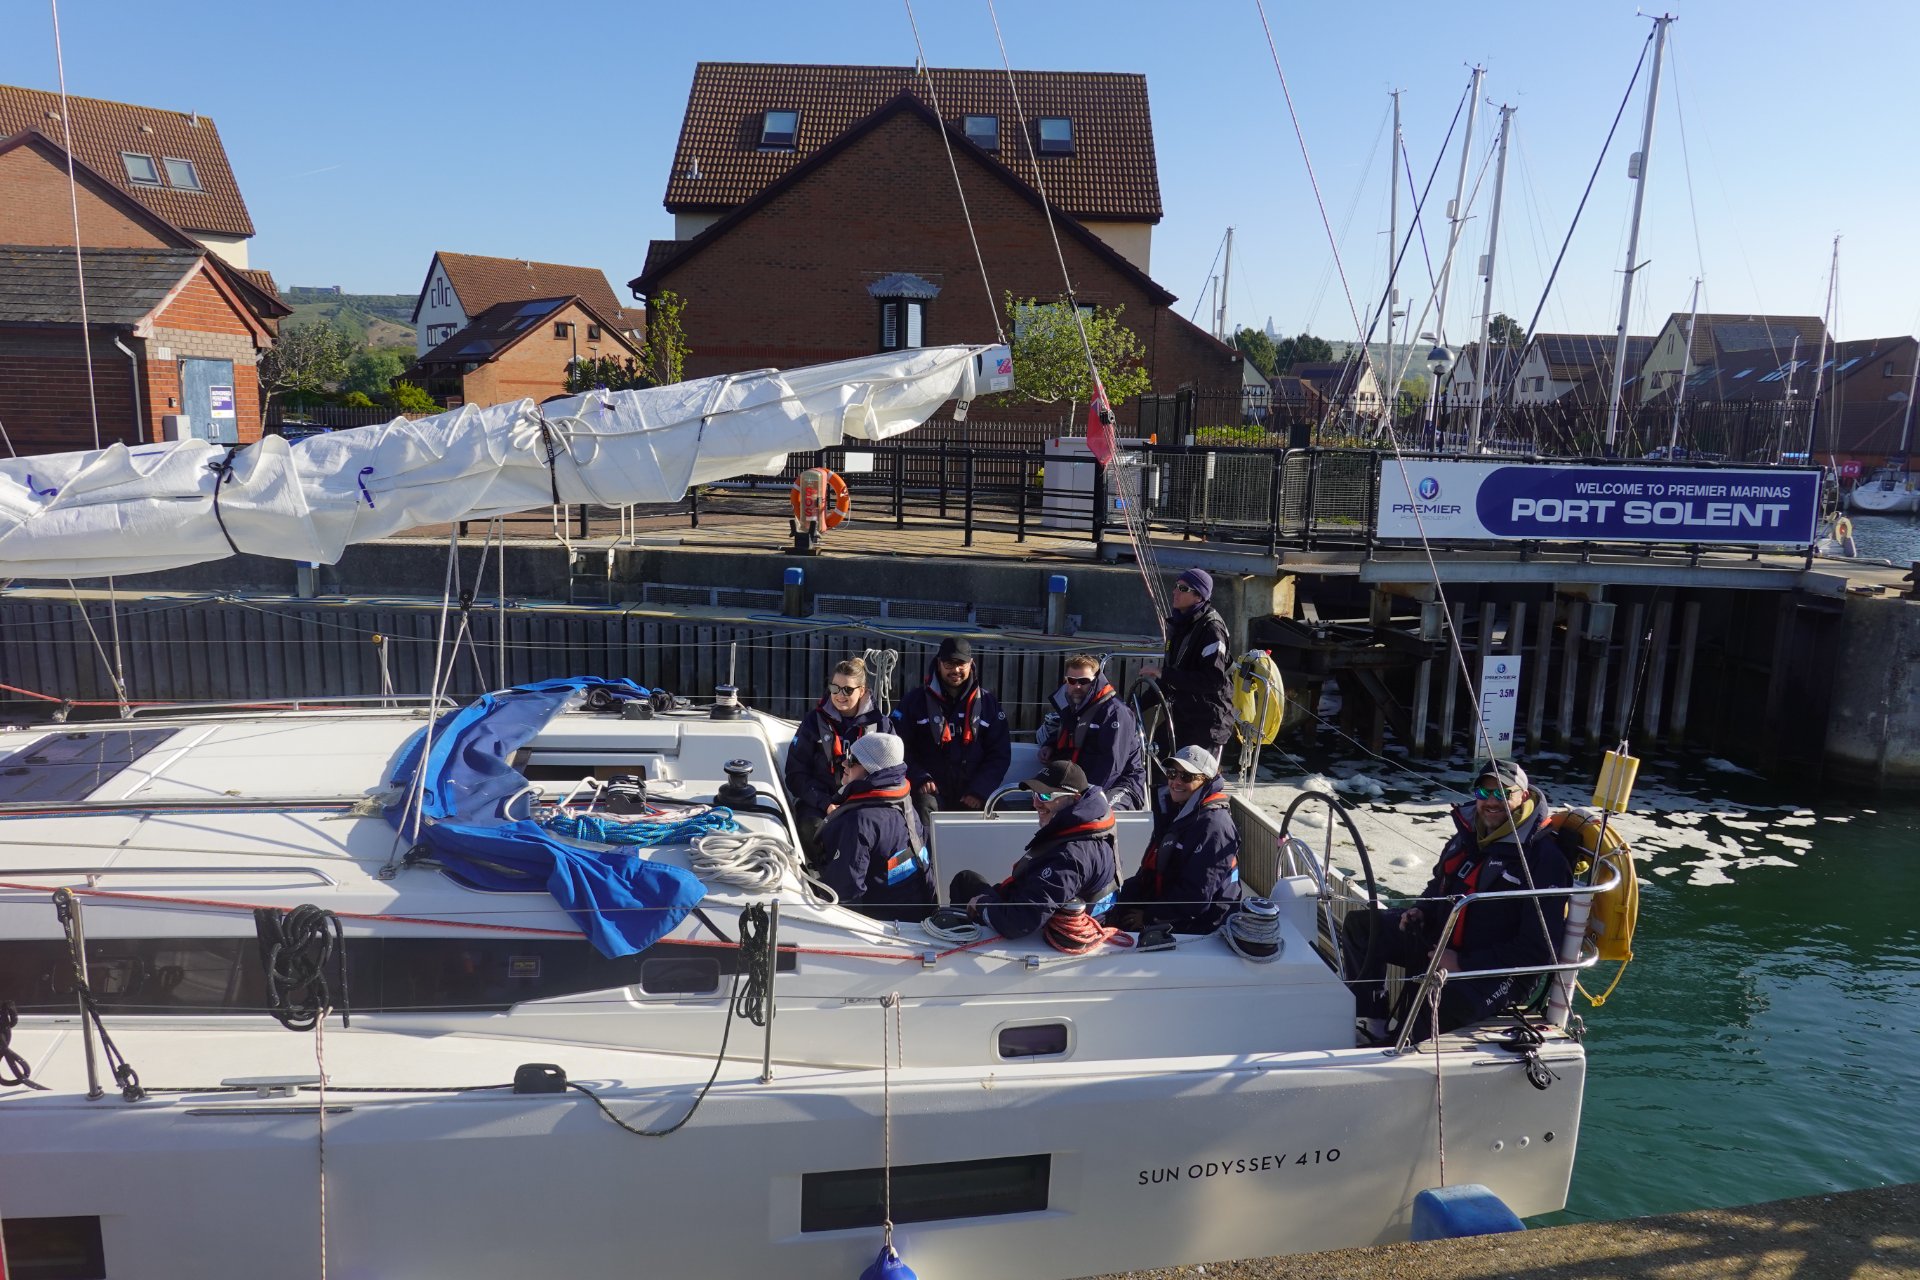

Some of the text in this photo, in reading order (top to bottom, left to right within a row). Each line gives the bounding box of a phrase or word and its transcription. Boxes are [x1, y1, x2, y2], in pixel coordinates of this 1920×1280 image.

[1576, 482, 1791, 498] WELCOME TO PREMIER MARINAS
[1392, 504, 1462, 514] PREMIER
[1511, 498, 1790, 526] PORT SOLENT
[1500, 689, 1514, 698] 3.5M
[1499, 733, 1510, 741] 3M
[1138, 1148, 1340, 1185] SUN ODYSSEY 410
